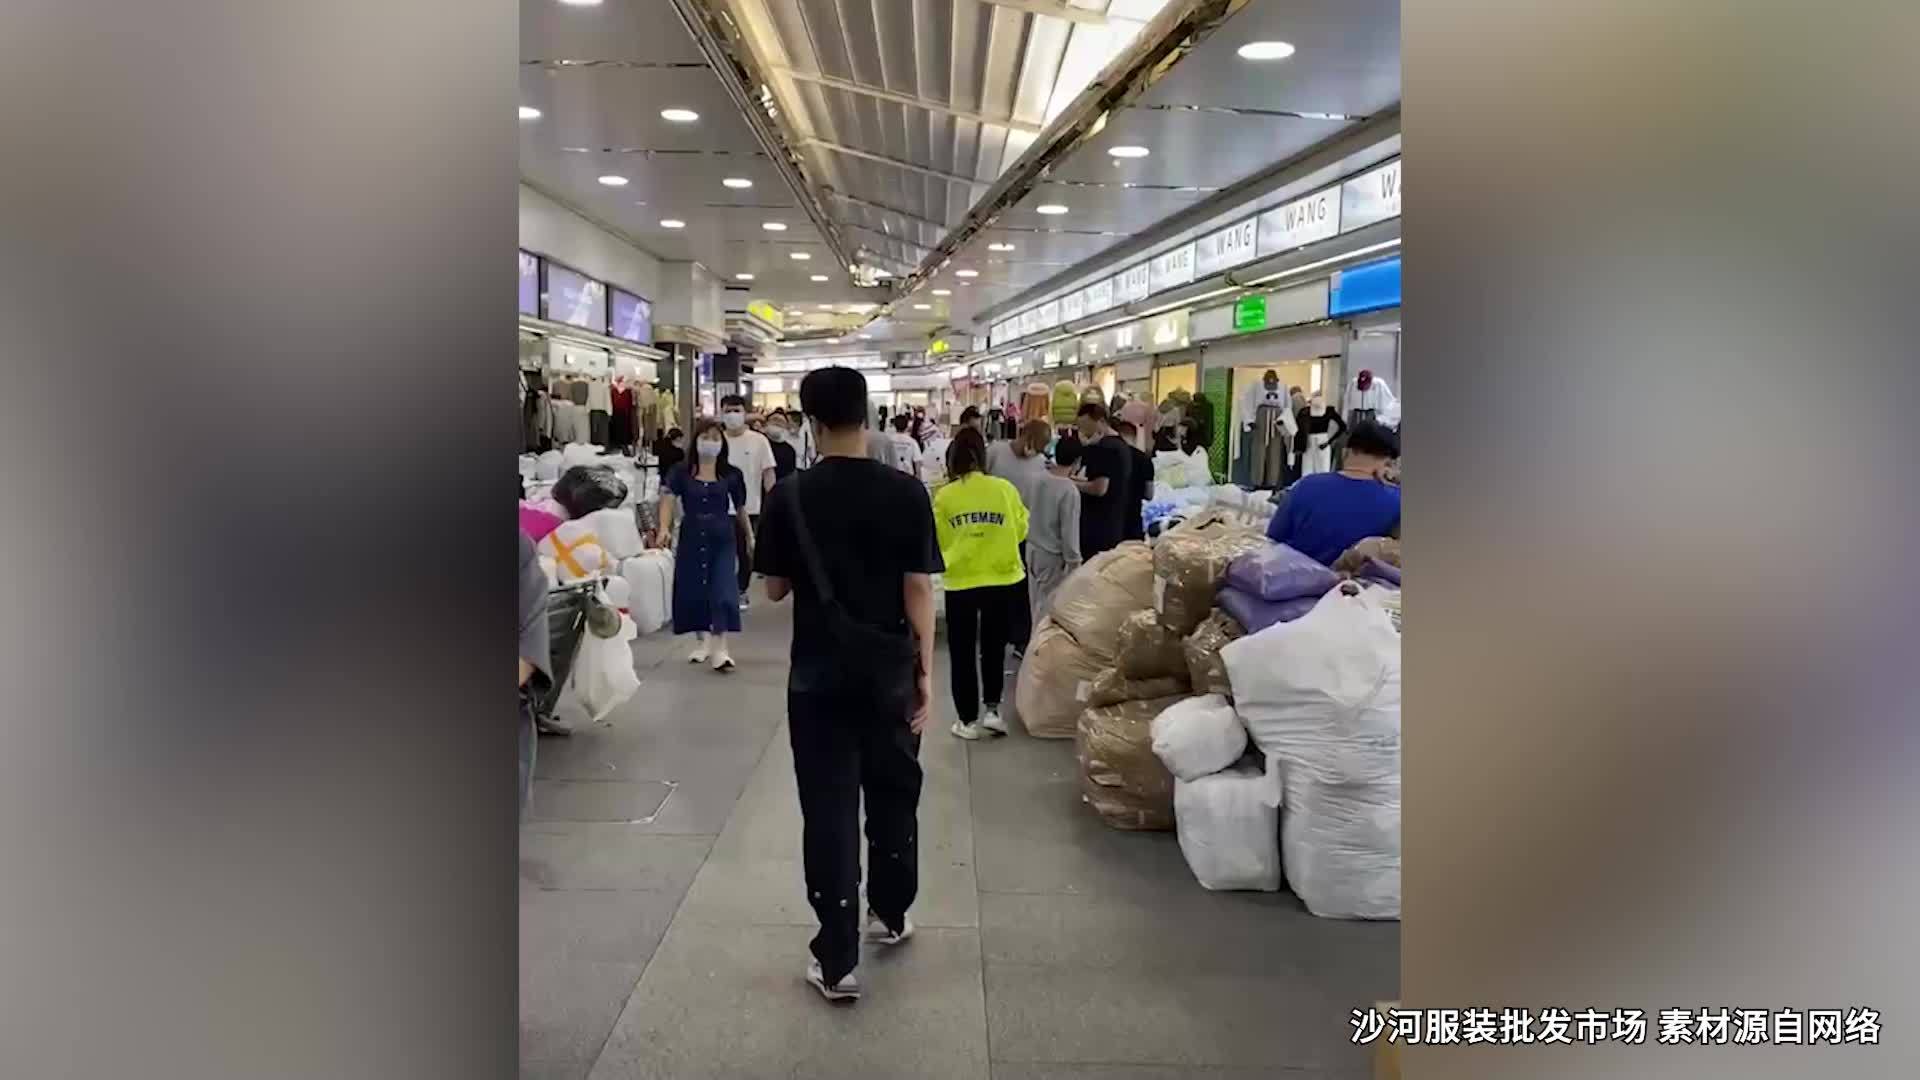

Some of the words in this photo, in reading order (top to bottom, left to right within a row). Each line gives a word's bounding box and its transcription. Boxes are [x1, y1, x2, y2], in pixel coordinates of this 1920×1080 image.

[1381, 169, 1401, 199] W
[1285, 198, 1326, 232] WANG
[1216, 224, 1250, 256] WANG
